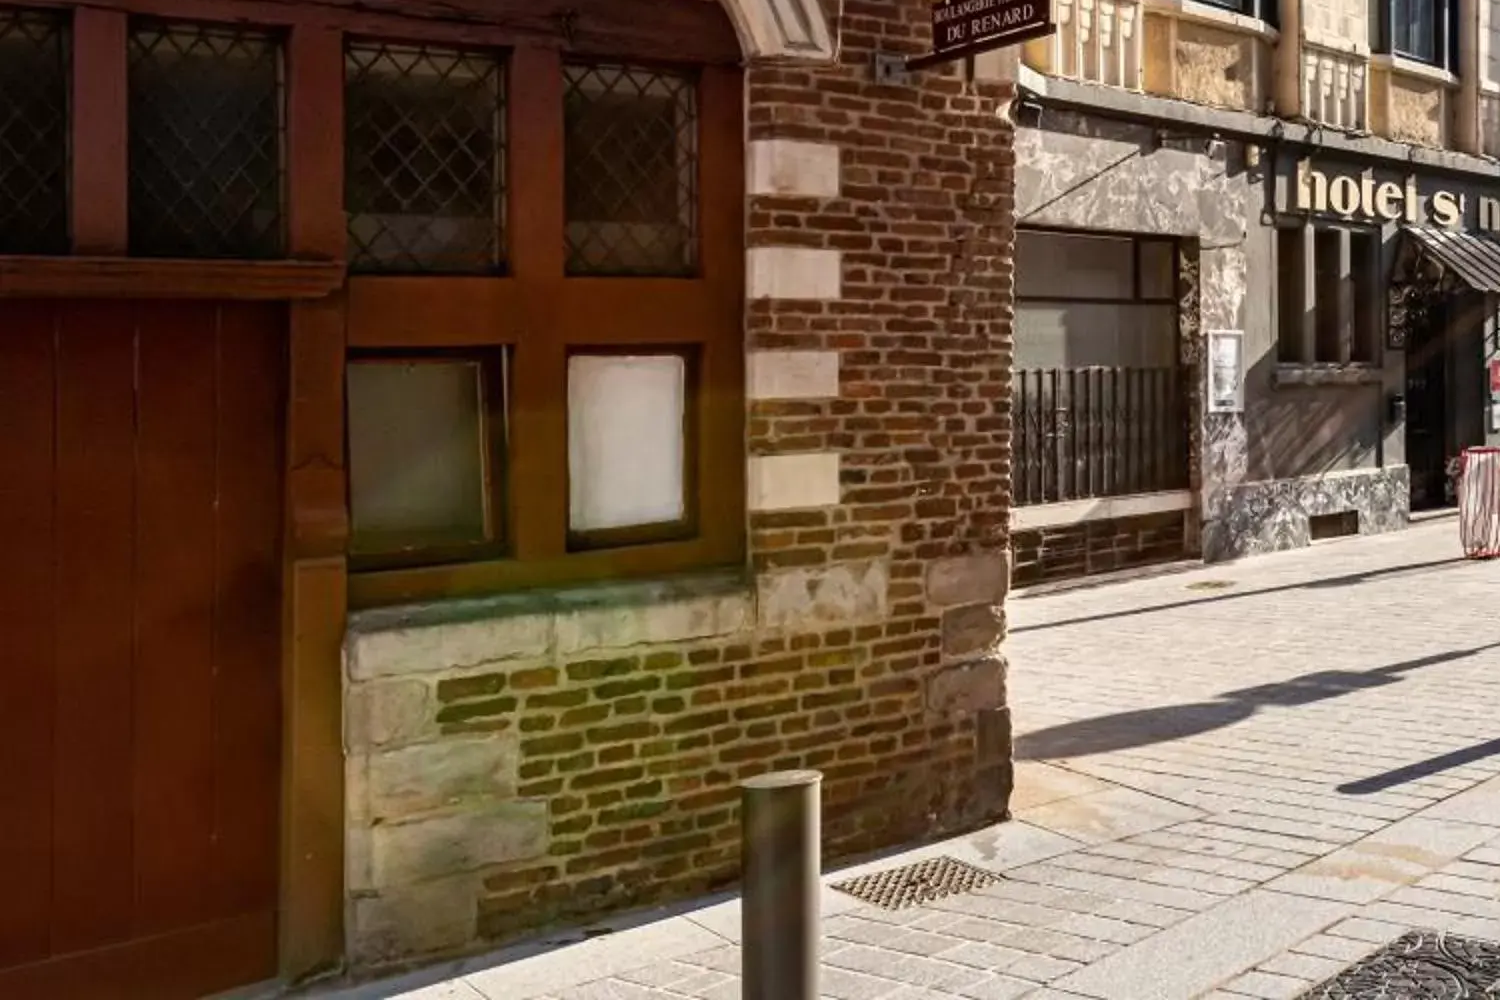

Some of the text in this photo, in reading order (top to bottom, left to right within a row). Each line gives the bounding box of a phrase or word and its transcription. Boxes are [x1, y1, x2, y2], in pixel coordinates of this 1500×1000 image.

[947, 3, 1034, 41] DU RENARD
[1297, 156, 1417, 221] hotel
